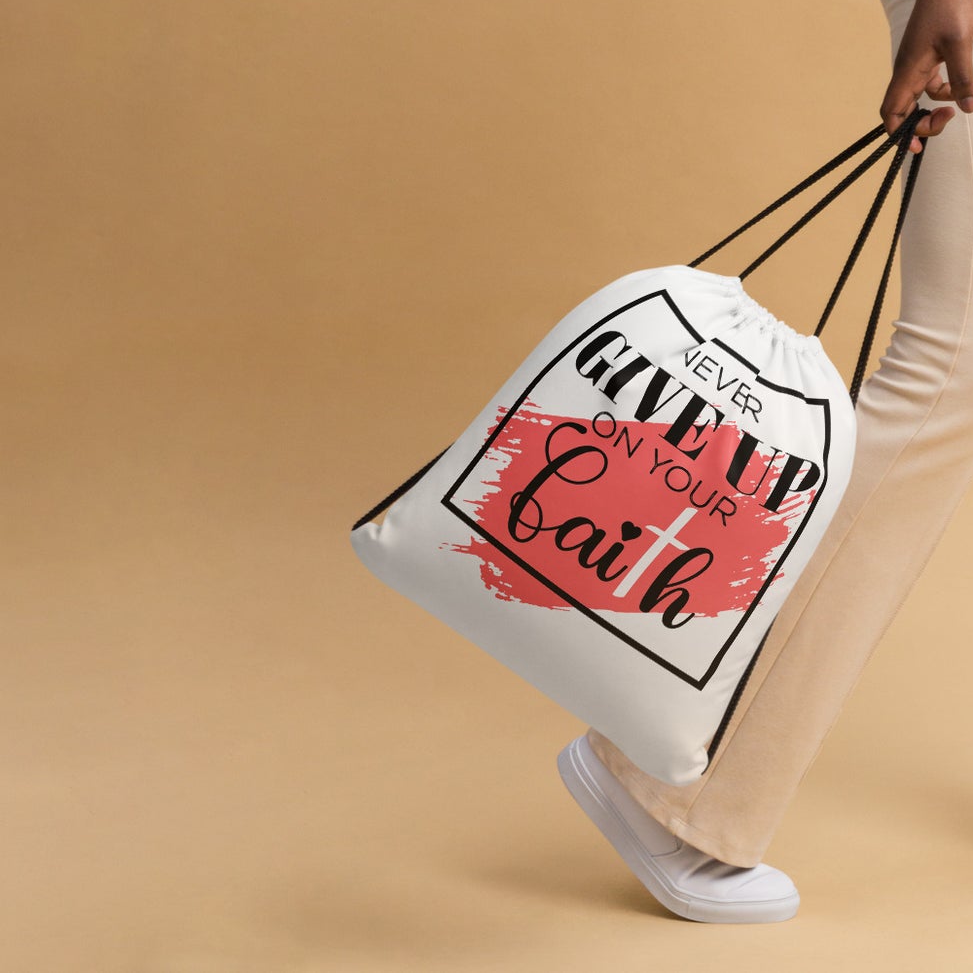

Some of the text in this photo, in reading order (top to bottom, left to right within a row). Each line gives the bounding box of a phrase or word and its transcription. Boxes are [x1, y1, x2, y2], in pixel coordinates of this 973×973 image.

[575, 330, 821, 515] GIVE UP
[592, 411, 737, 527] ON YOUR
